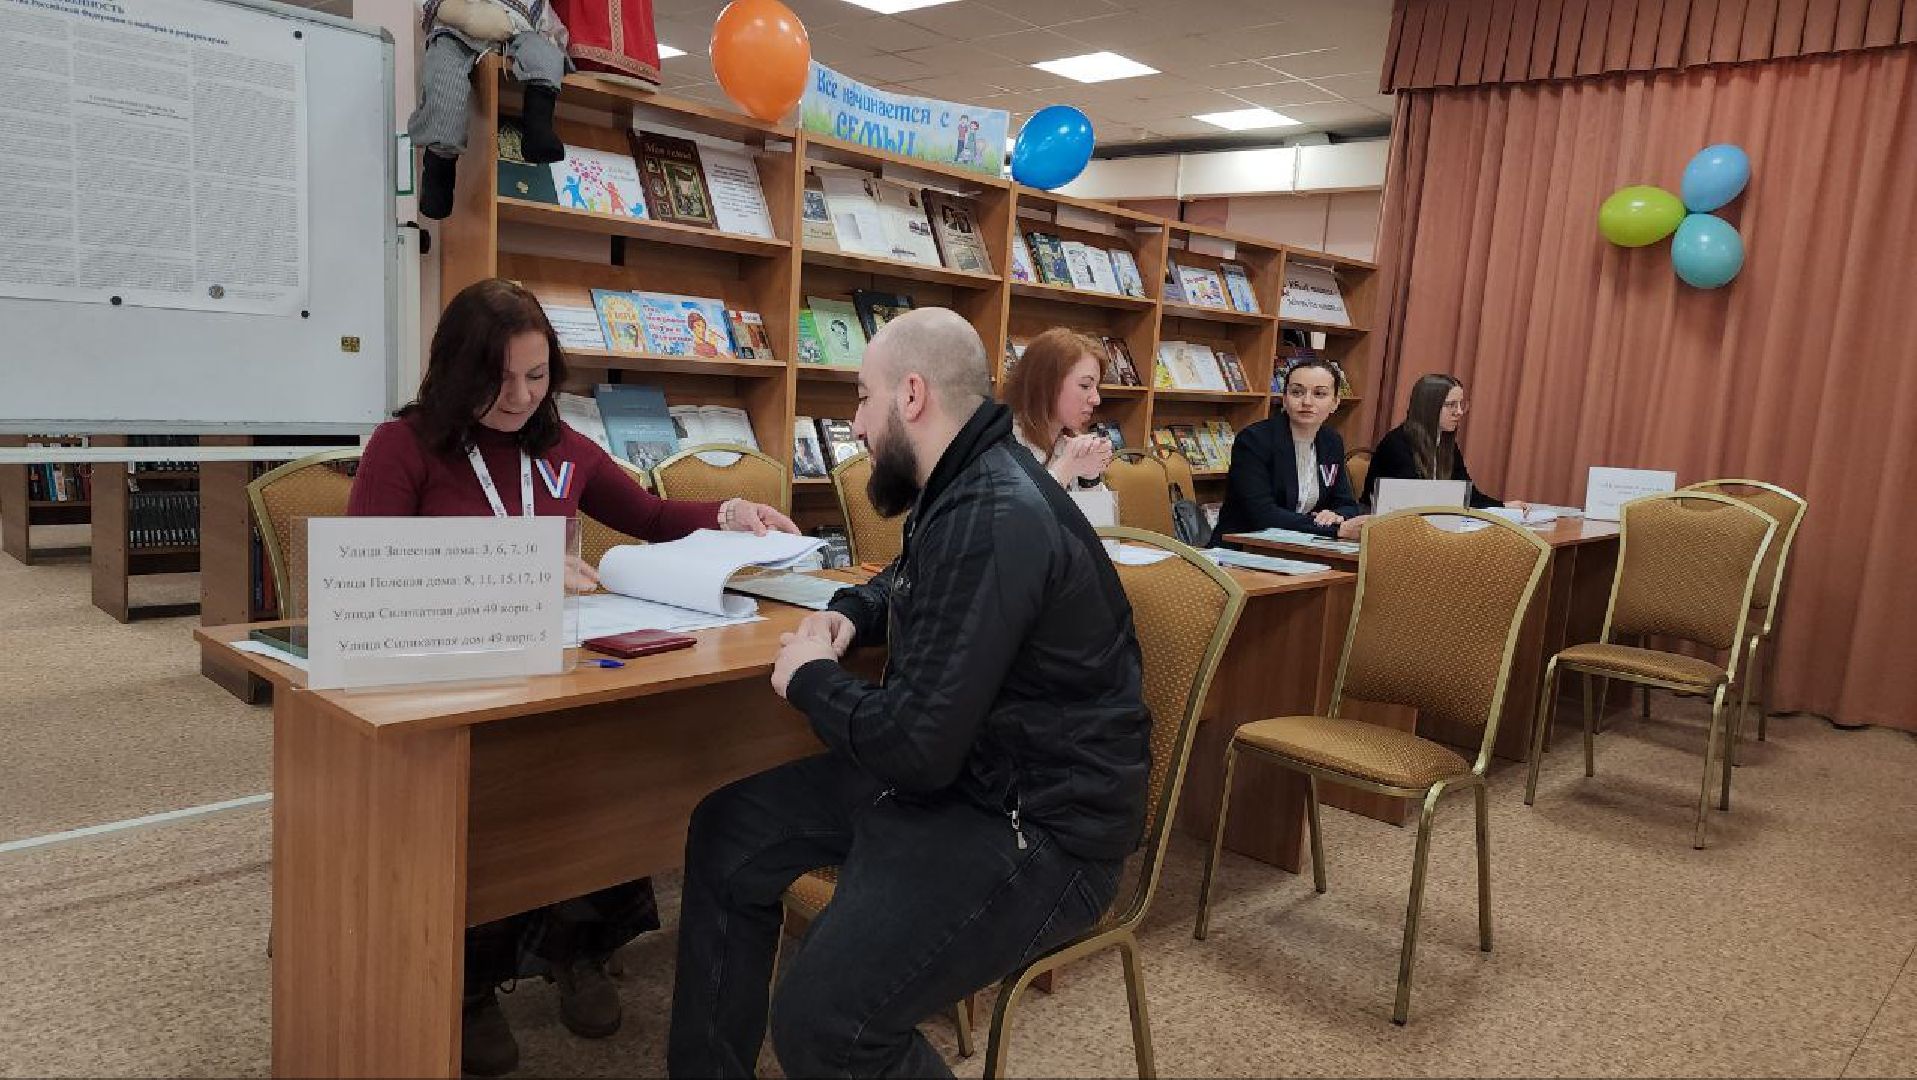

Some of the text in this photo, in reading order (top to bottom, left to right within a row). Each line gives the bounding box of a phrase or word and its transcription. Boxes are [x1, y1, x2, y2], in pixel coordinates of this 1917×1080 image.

[842, 86, 931, 126] начинается
[939, 112, 949, 128] с
[384, 637, 457, 649] Силикатная
[488, 632, 502, 644] 49
